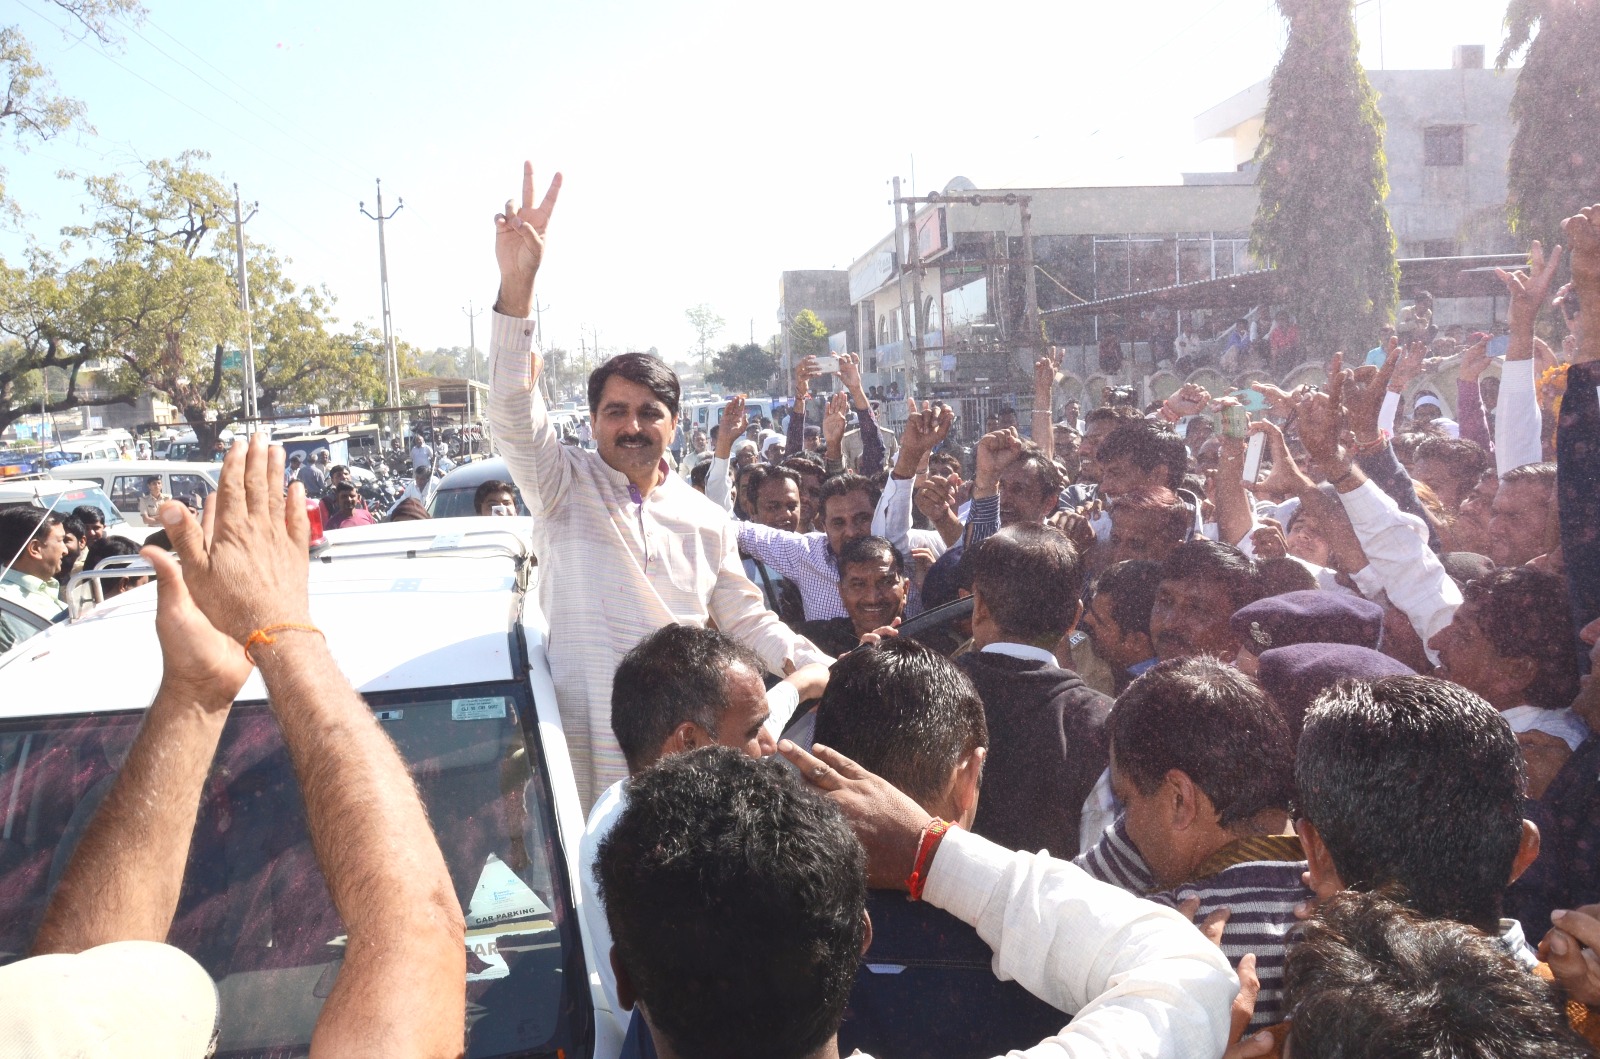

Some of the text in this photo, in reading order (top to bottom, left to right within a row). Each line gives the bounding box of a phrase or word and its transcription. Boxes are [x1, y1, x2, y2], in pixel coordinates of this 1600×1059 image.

[475, 907, 535, 924] CAR PARKING
[466, 942, 499, 957] AR
